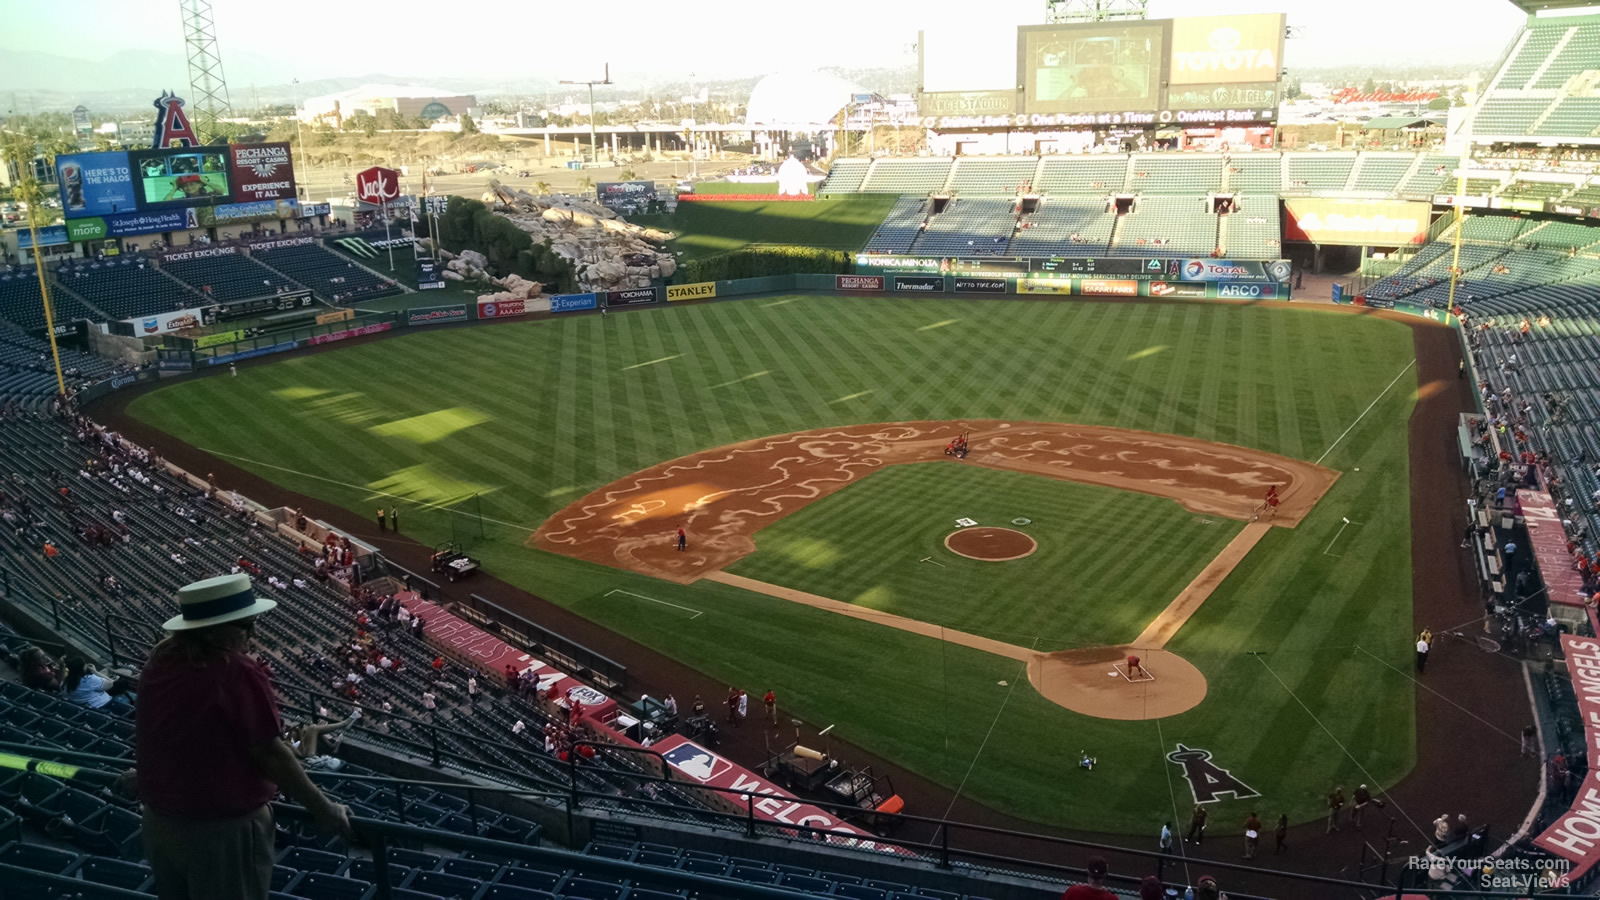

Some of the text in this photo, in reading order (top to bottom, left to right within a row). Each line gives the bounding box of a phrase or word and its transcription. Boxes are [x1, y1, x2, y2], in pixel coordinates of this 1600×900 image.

[1175, 48, 1275, 72] TOYOTA
[1330, 87, 1440, 105] Budweiser
[930, 95, 1009, 111] ANGEL STADIUM
[1031, 113, 1055, 125] One
[1056, 113, 1096, 124] Person
[1098, 113, 1111, 123] at
[1177, 110, 1226, 122] OneWest
[1226, 109, 1254, 121] Bank
[235, 147, 287, 158] PECHANGA
[84, 167, 129, 177] HERE'S TO
[103, 175, 131, 184] HALOS
[360, 170, 398, 200] Jack
[242, 181, 290, 192] EXPERIENCE
[265, 190, 280, 198] ALL
[161, 213, 181, 222] Health
[73, 225, 101, 236] more
[250, 242, 275, 251] TICKET
[164, 251, 193, 262] TICKET
[868, 258, 938, 267] KONICA MINOLTA
[1207, 265, 1247, 273] TOTAL
[841, 277, 879, 285] PECHANGA
[896, 282, 934, 290] Thermador
[619, 290, 654, 299] YOKOHAMA
[668, 286, 714, 298] STANLEY
[1221, 285, 1260, 297] ARCO
[561, 298, 592, 308] Experian
[111, 375, 136, 389] Corona
[574, 687, 601, 702] FOX
